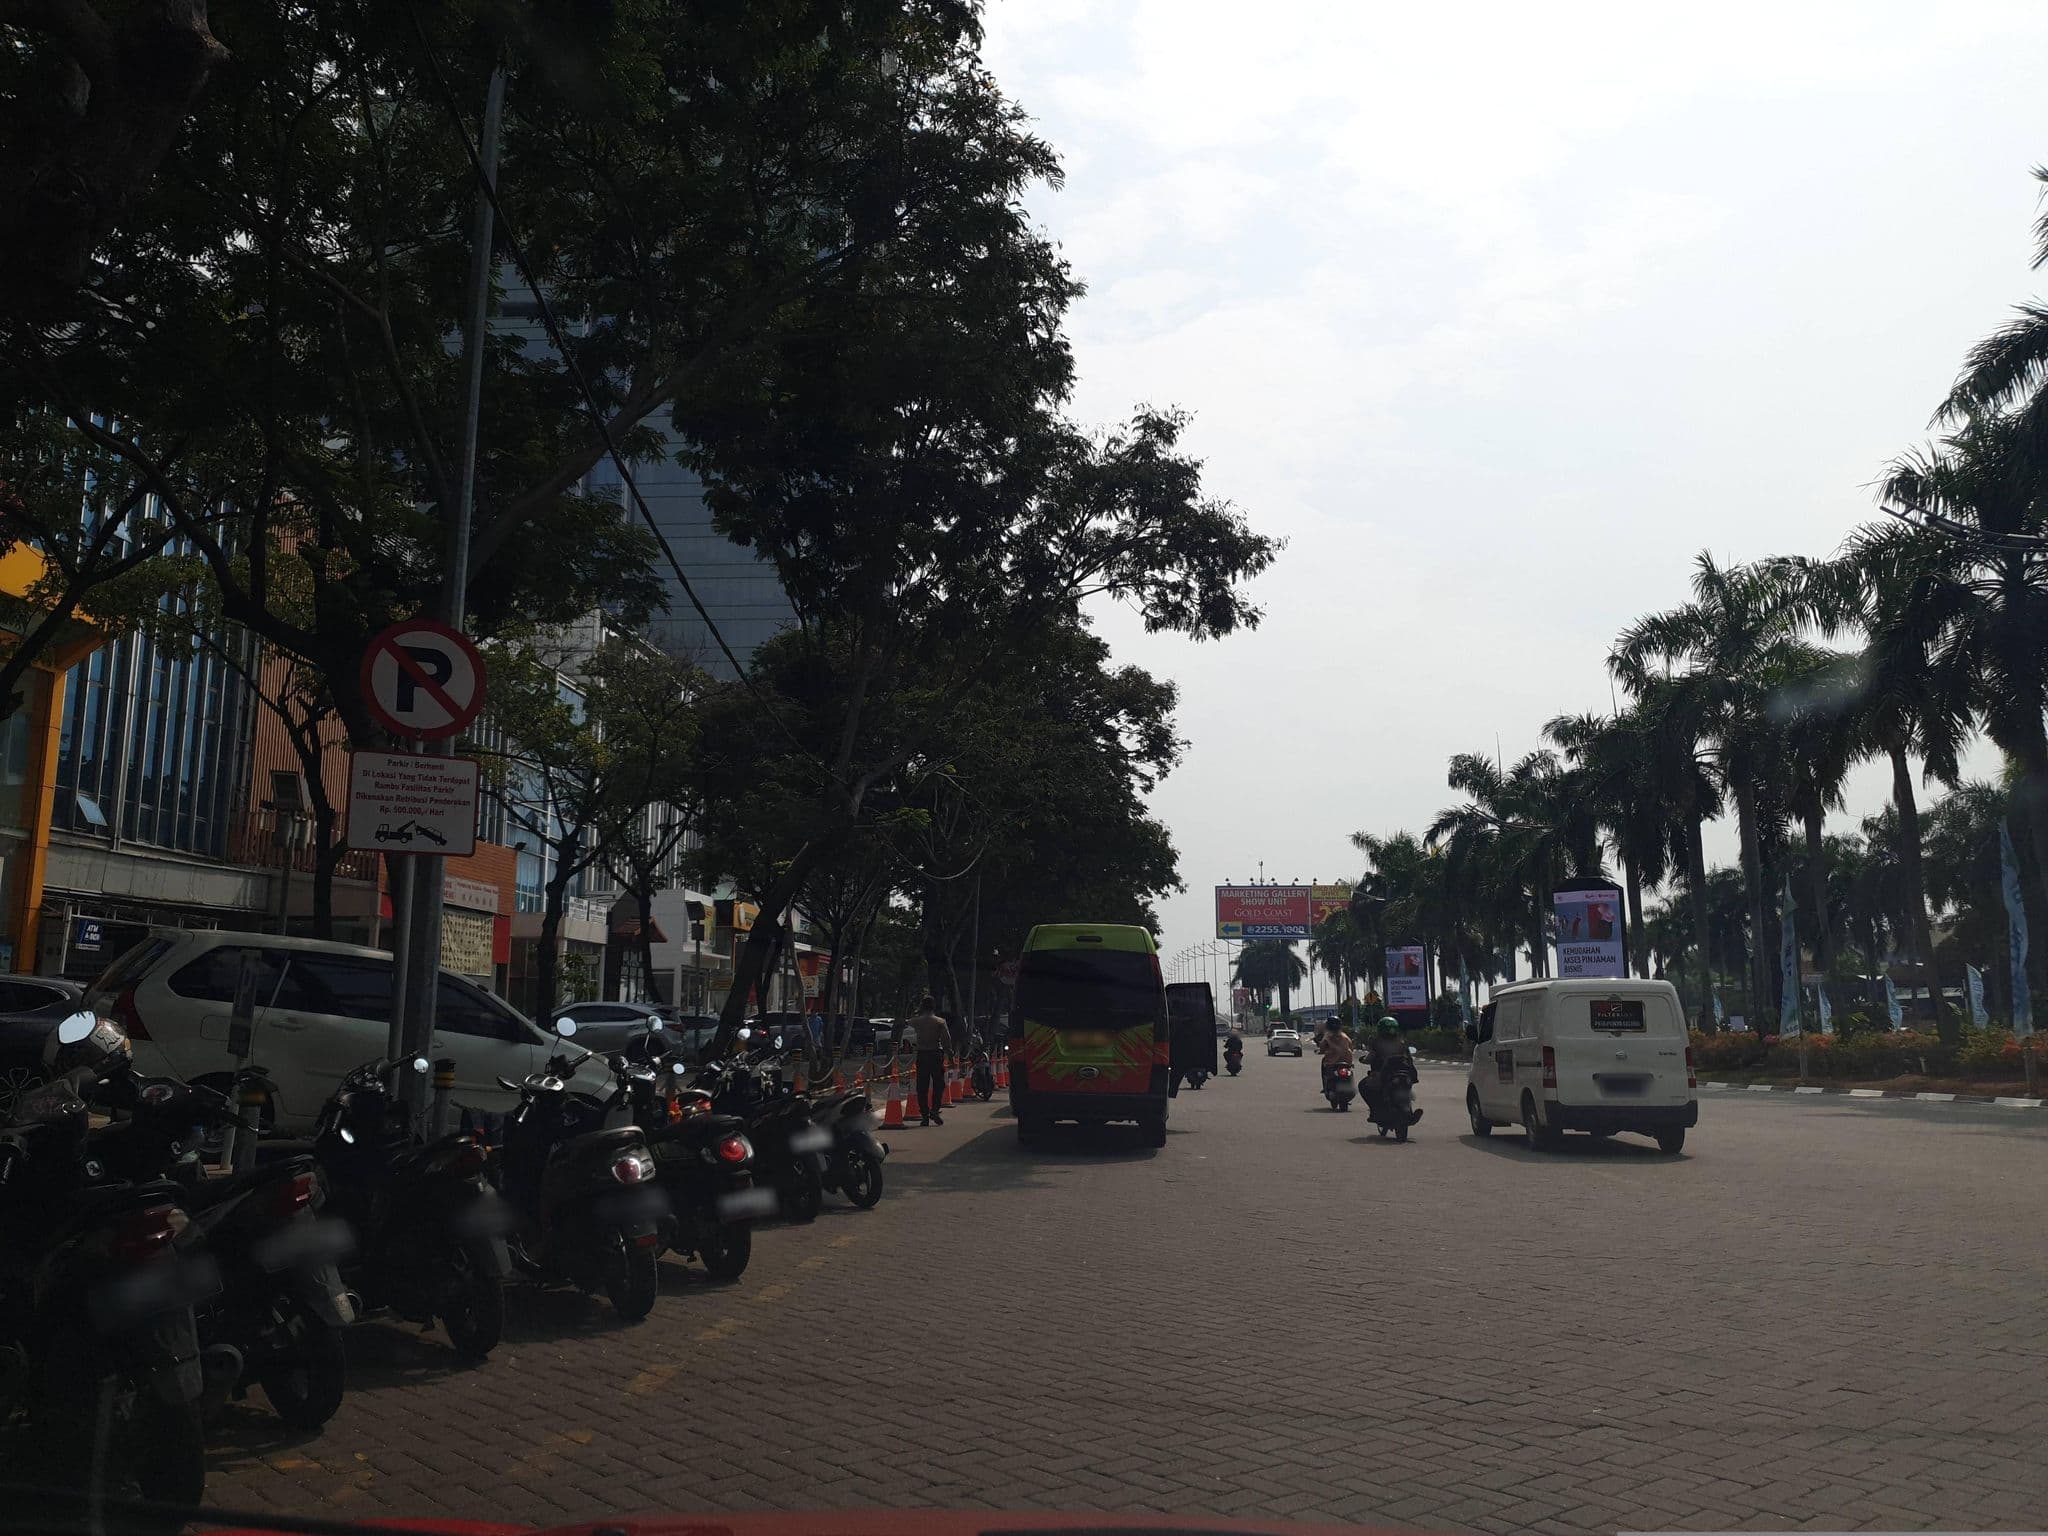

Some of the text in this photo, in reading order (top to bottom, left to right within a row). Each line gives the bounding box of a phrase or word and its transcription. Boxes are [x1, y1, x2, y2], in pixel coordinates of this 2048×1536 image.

[387, 759, 409, 768] Parkir
[372, 770, 396, 779] Lokasi
[398, 773, 416, 782] Yang
[418, 774, 437, 782] Tidak
[375, 781, 455, 793] Rambu Fasilitas Parkir
[355, 792, 394, 802] Dikenakan
[395, 795, 428, 804] Retribusi
[1221, 890, 1270, 898] MARKETING
[1271, 890, 1307, 898] GALLERY
[1240, 898, 1287, 906] SHOW UNIT
[1234, 909, 1293, 918] GOLD COAST
[1582, 954, 1616, 963] PINJAMAN
